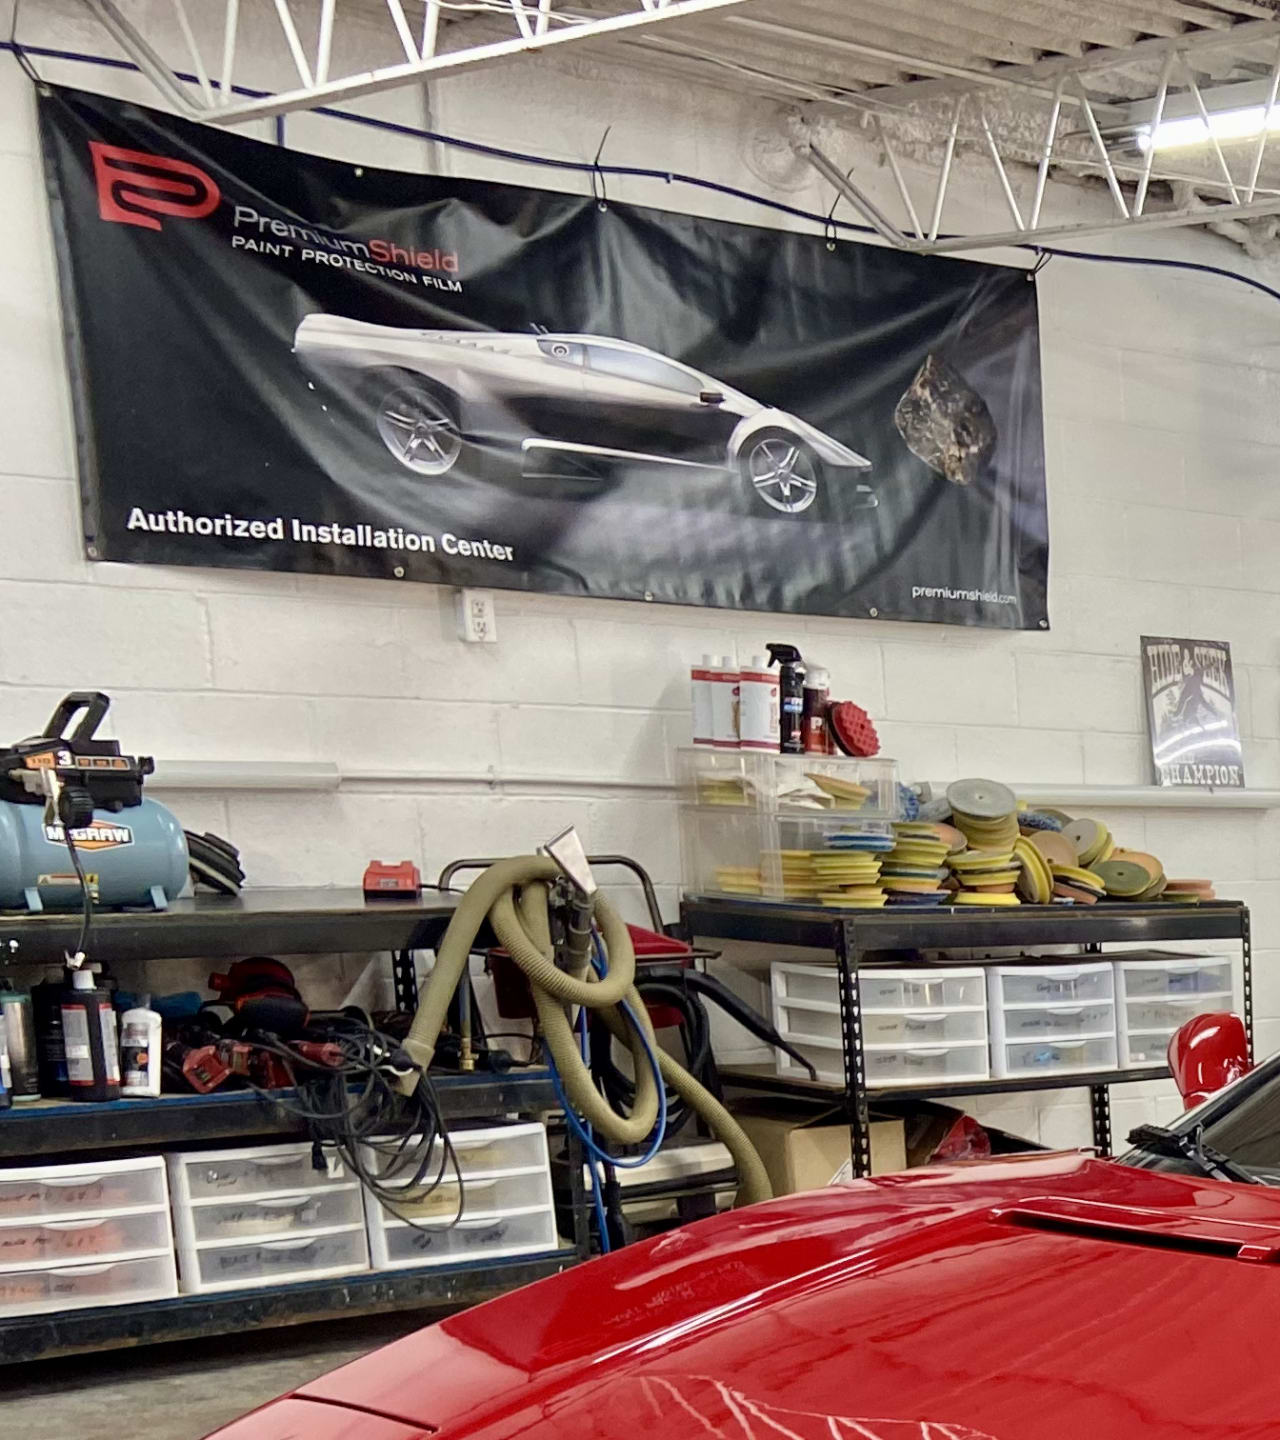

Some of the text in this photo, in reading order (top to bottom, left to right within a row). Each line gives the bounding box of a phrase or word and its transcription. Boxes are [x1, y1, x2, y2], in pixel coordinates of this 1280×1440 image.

[234, 205, 459, 273] PremiumShield
[231, 235, 463, 293] PAINT PROTECTION FILM
[126, 506, 515, 562] Authorized Installation Center
[911, 585, 1017, 605] premiumshield.com
[1147, 645, 1183, 694] HIDE
[1183, 649, 1194, 675] &
[57, 750, 72, 766] 3
[1160, 765, 1240, 787] CHAMPION
